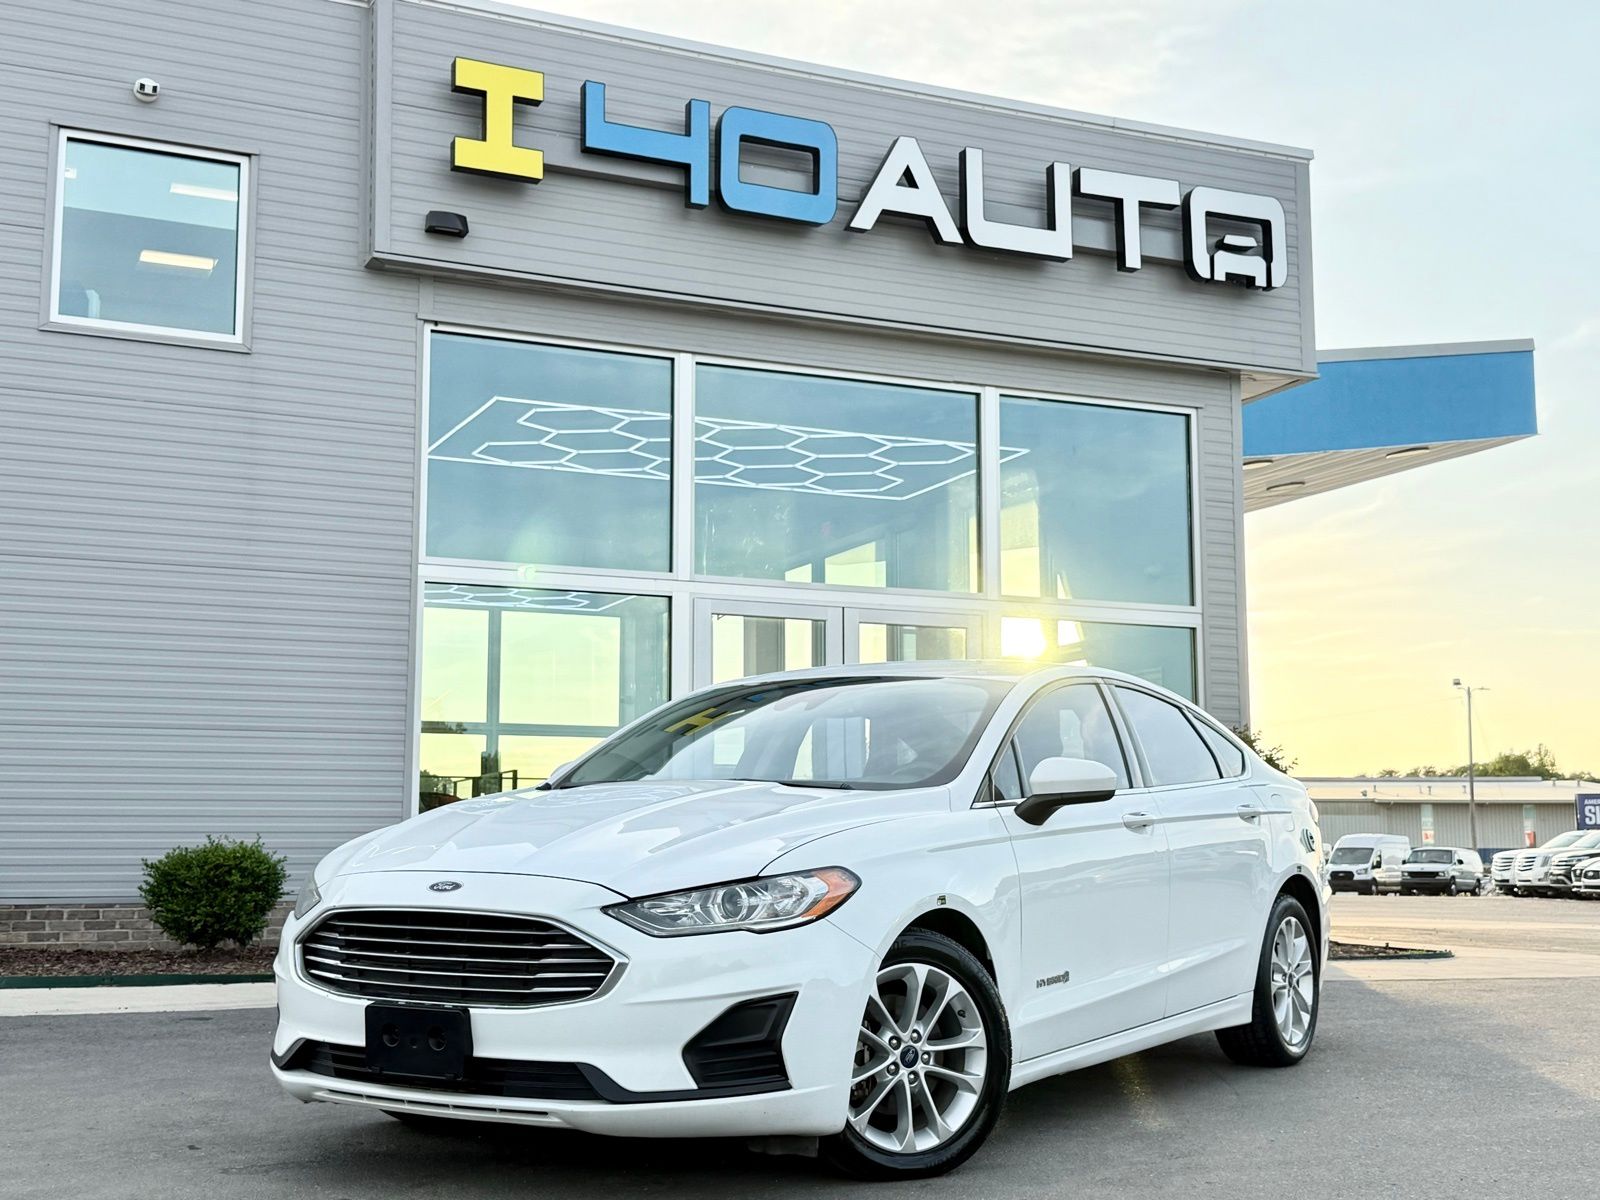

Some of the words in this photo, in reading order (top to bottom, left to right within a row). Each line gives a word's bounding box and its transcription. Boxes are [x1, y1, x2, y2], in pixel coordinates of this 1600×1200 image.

[451, 56, 544, 184] I
[580, 80, 838, 226] 40
[845, 136, 1287, 291] AUTO
[432, 881, 458, 891] Ford
